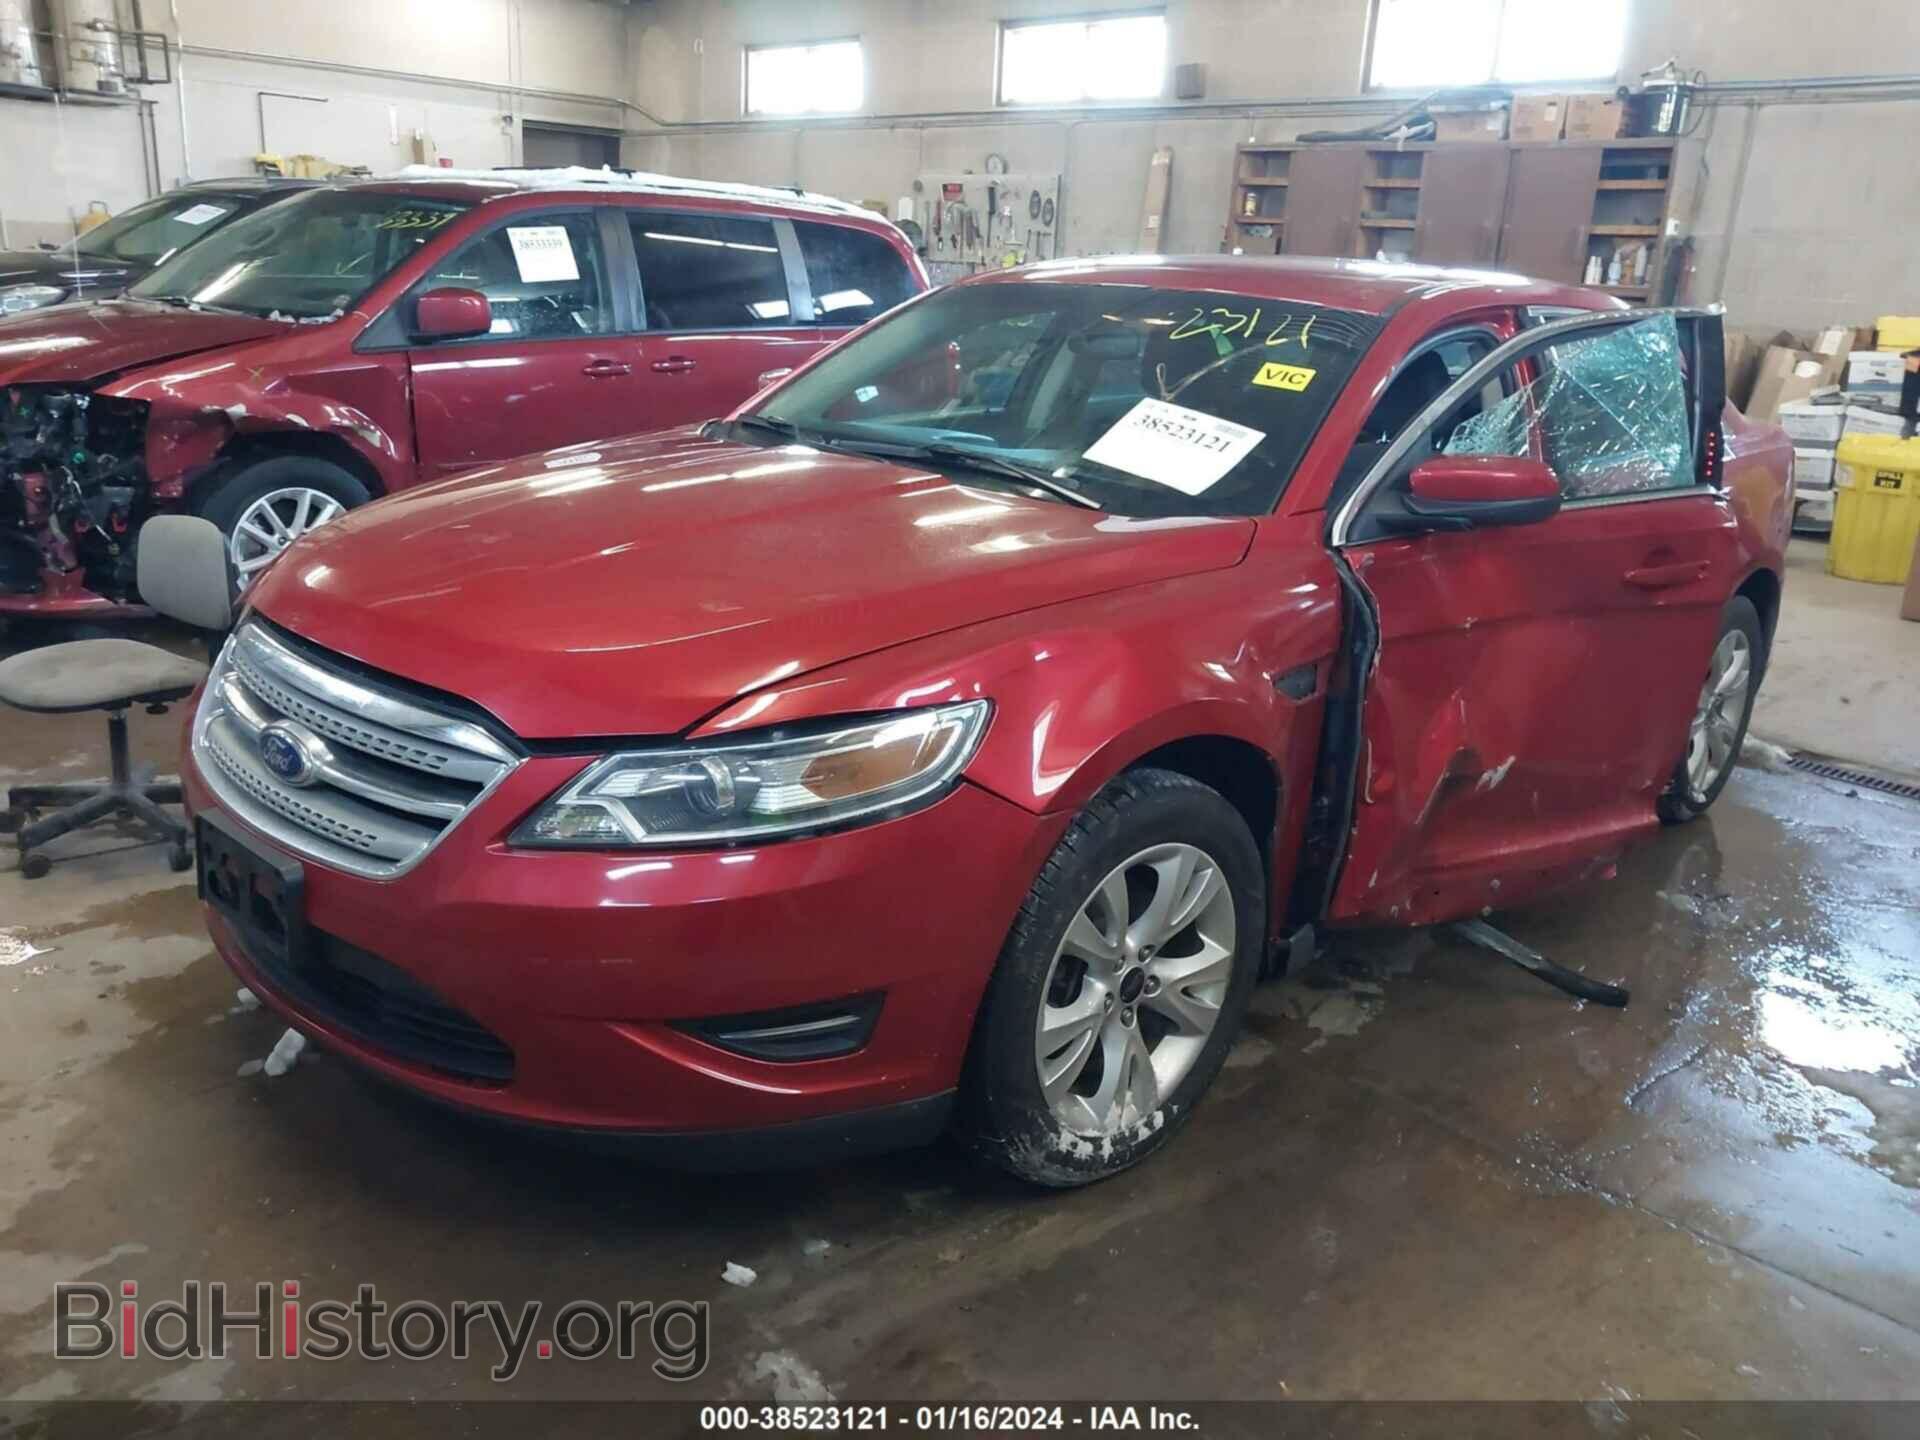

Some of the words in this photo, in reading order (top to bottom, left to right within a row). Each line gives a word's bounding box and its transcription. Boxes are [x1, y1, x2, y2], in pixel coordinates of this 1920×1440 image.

[1264, 368, 1307, 386] VIC
[1133, 413, 1233, 453] 38523121
[264, 735, 294, 772] Ford
